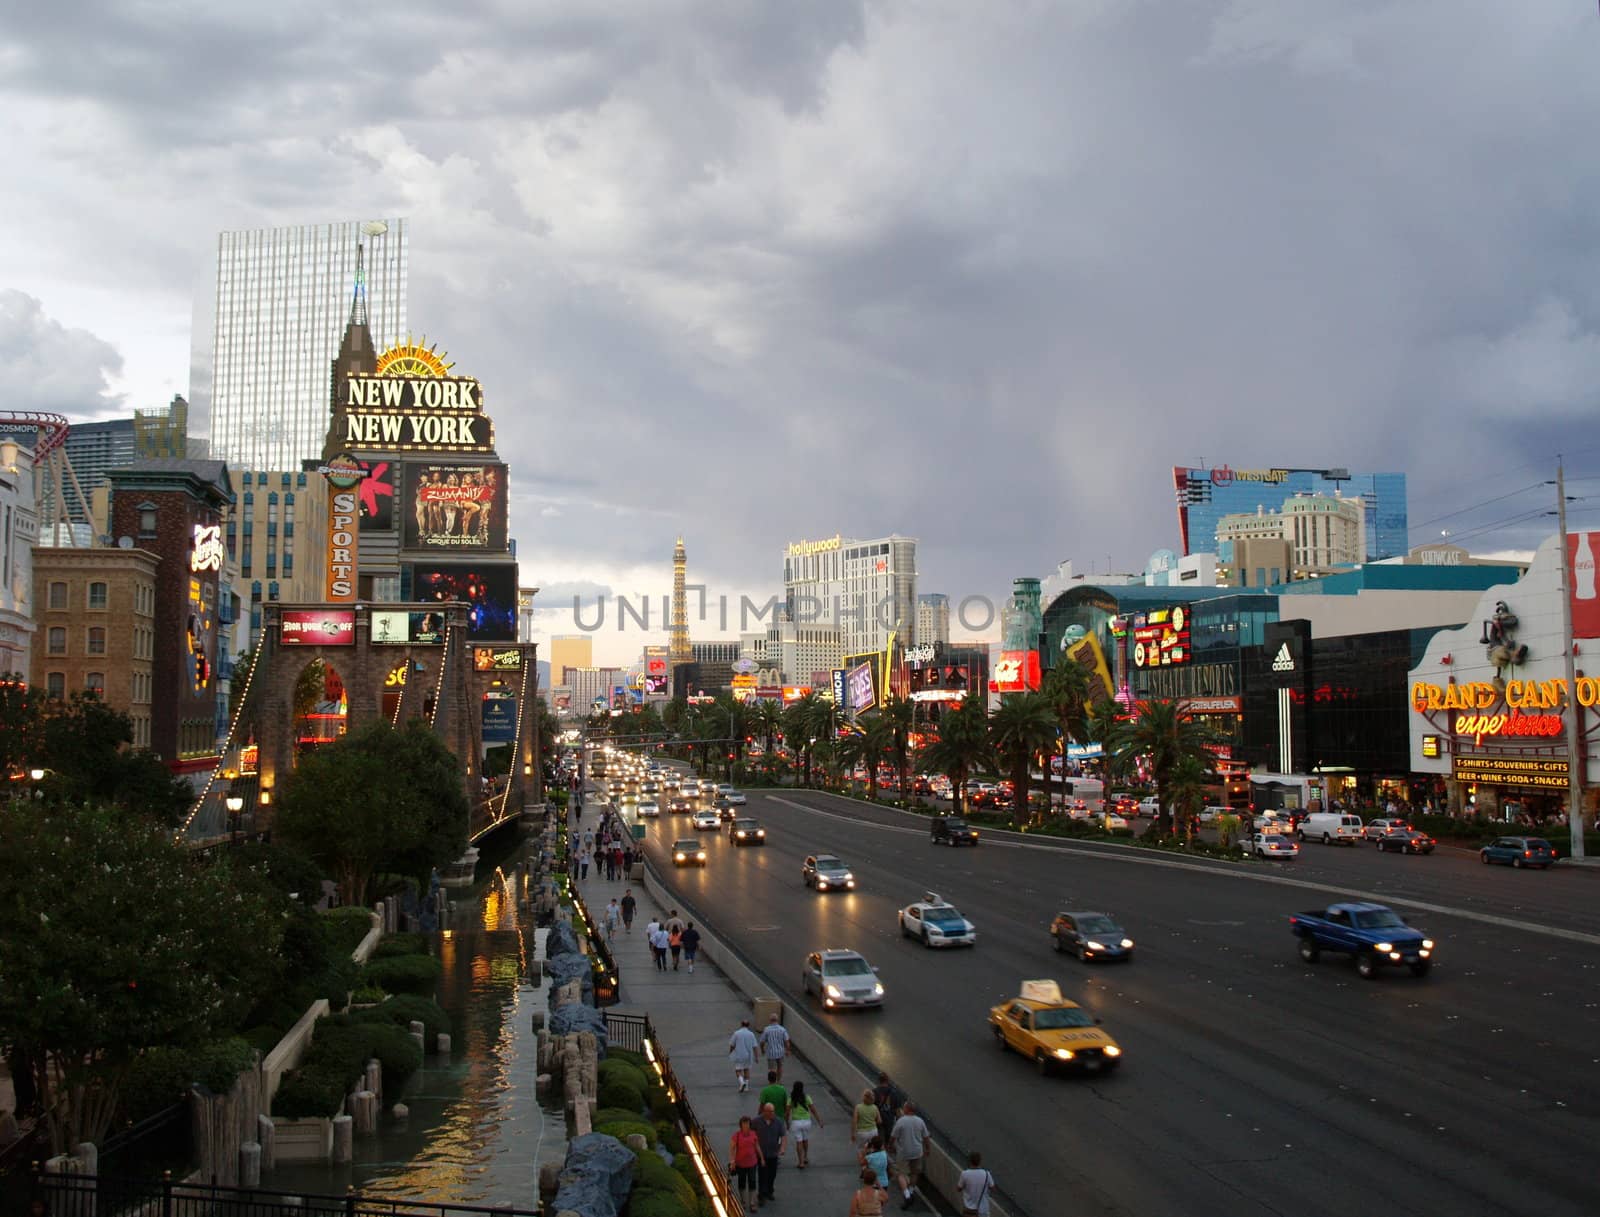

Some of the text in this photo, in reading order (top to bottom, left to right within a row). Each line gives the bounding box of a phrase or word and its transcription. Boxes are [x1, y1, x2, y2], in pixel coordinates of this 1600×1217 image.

[347, 379, 477, 408] NEW YORK
[346, 414, 476, 444] NEW YORK
[1235, 469, 1289, 482] WESTGATE
[427, 487, 484, 500] ZUMANITY
[331, 493, 355, 596] SPORTS
[789, 533, 840, 556] hollywood
[1411, 681, 1497, 713] GRAND
[1455, 708, 1563, 747] experience
[1494, 760, 1539, 770] SOUVENIRS
[1543, 762, 1568, 771] GIFTS
[1457, 772, 1569, 786] BEER WINE SODA SNACKS
